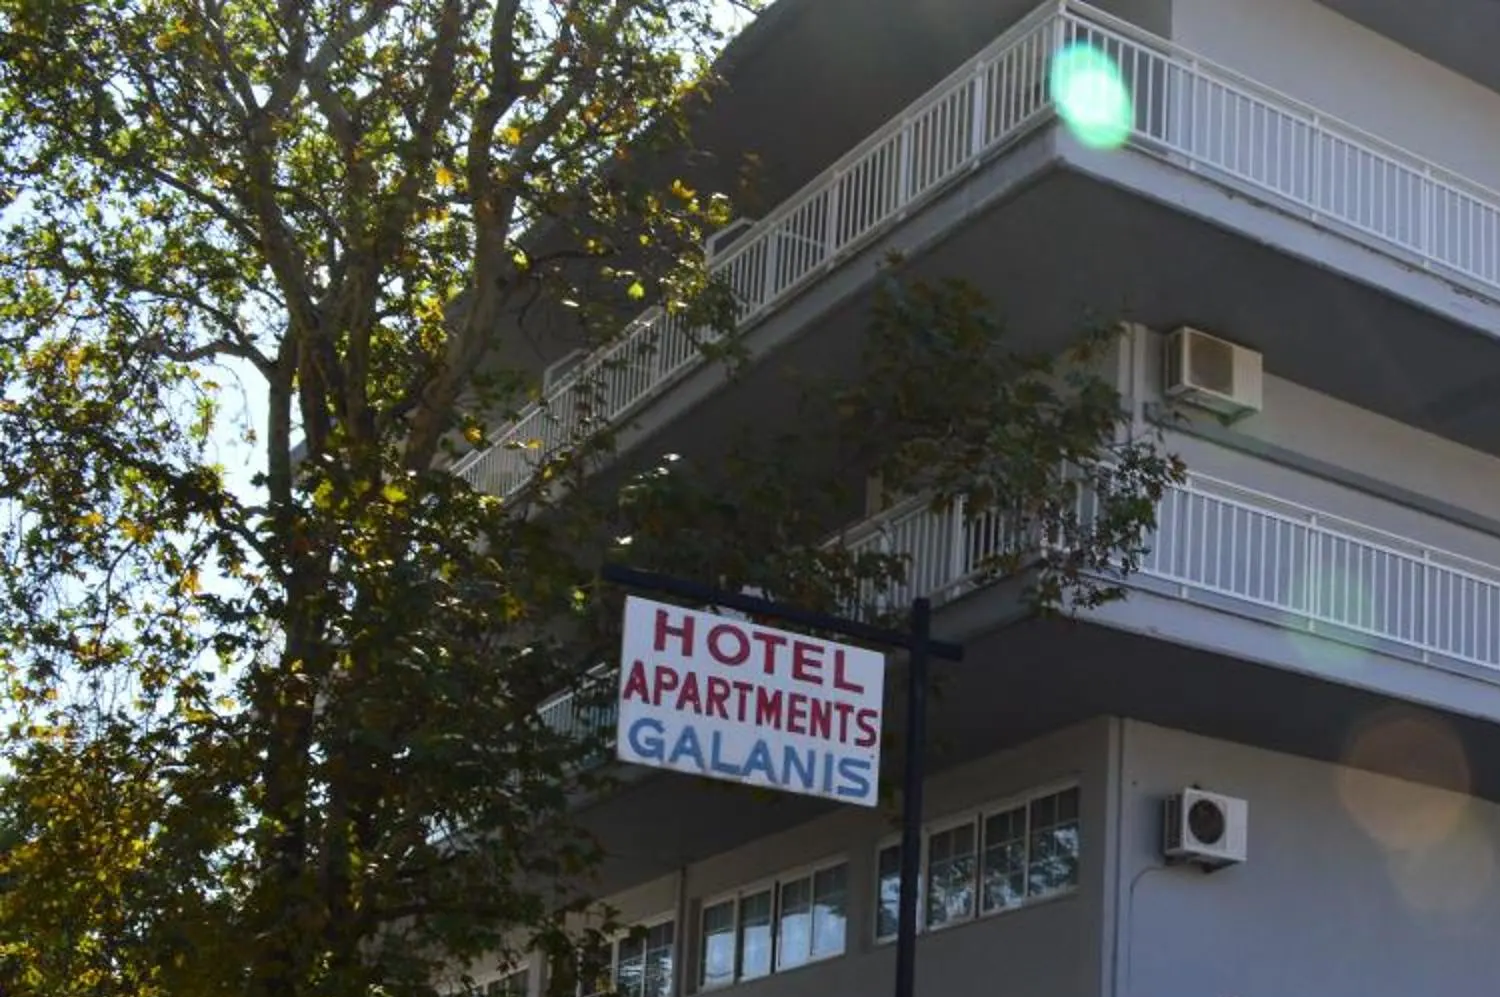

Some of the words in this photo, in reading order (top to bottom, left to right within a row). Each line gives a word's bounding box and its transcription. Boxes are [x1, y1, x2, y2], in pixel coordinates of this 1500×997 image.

[653, 609, 864, 694] HOTEL
[623, 659, 878, 747] APARTMENTS
[628, 717, 871, 799] GALANIS
